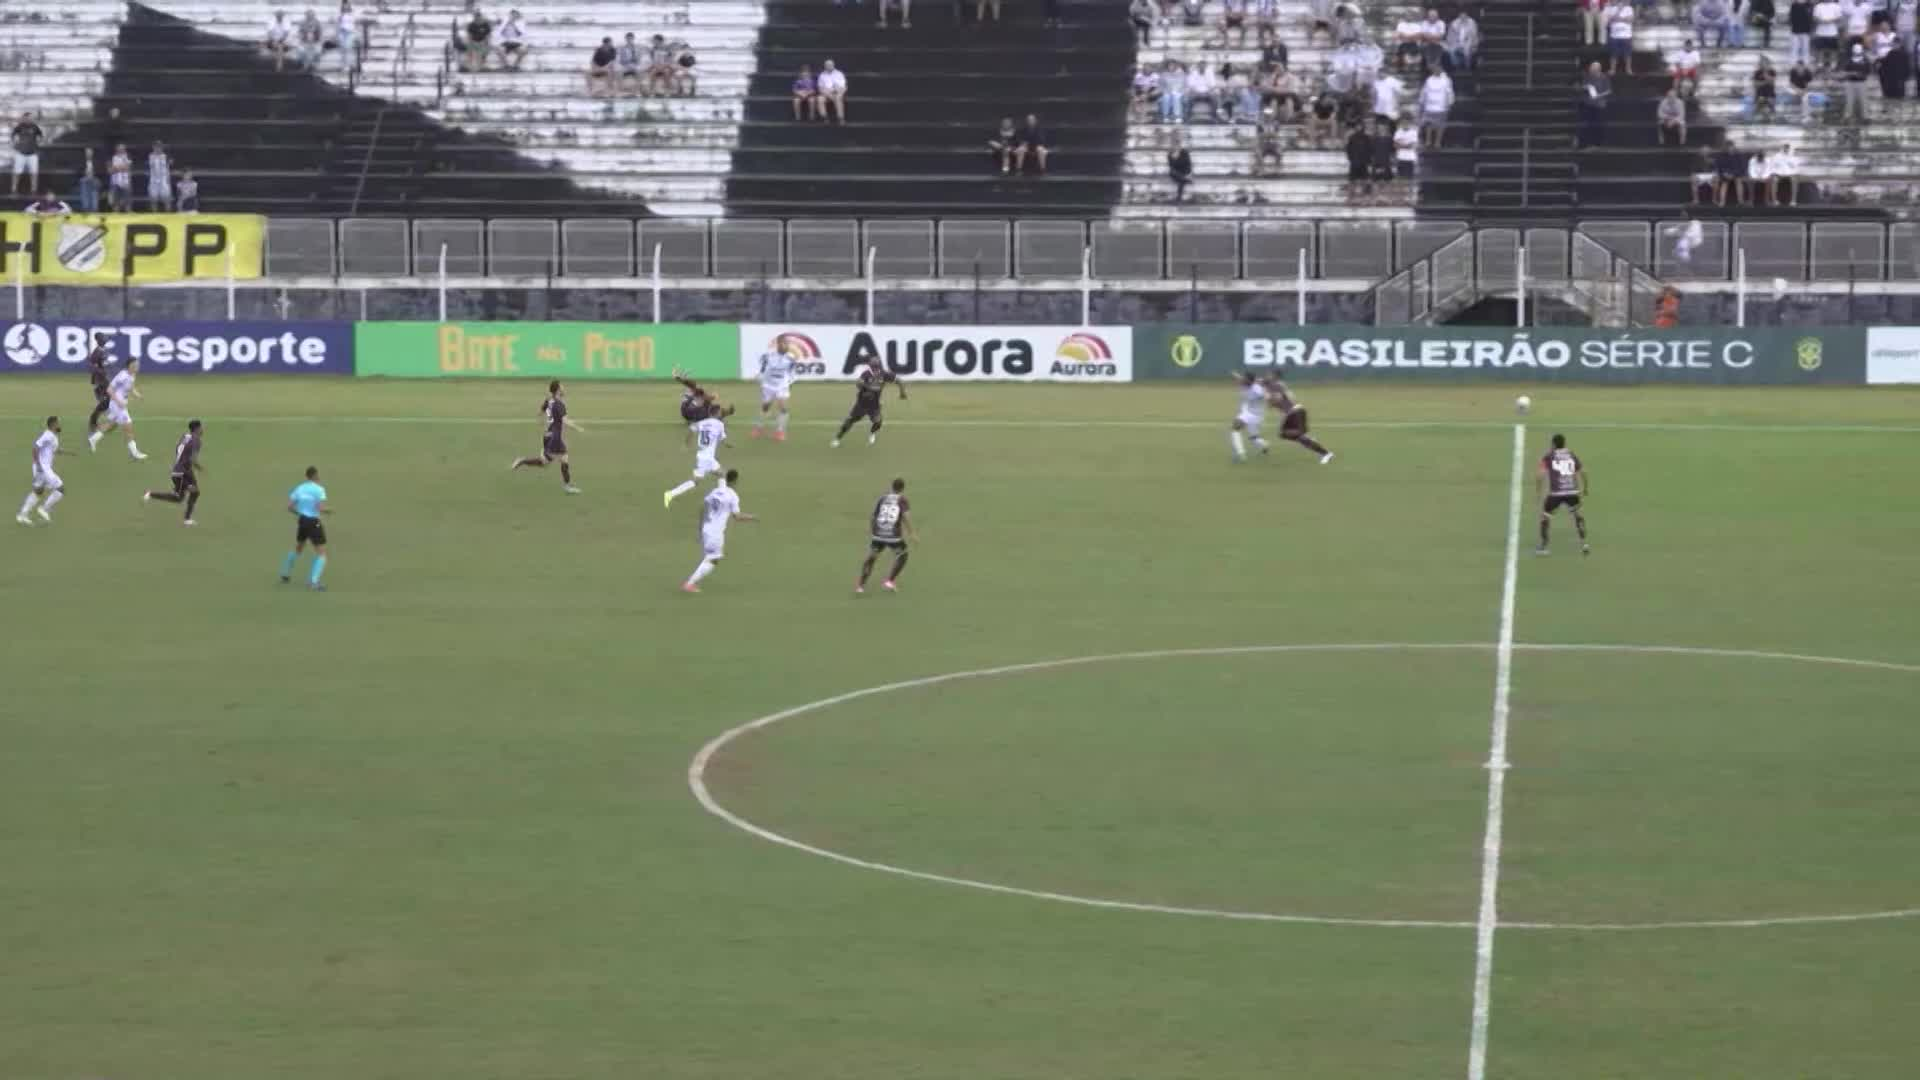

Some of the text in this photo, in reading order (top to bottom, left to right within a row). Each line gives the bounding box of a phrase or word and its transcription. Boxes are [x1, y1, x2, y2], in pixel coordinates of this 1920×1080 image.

[842, 331, 1033, 377] Aurora
[1243, 333, 1754, 368] BRASILEIRÃO SÉRIE C
[1050, 361, 1117, 376] Aurora
